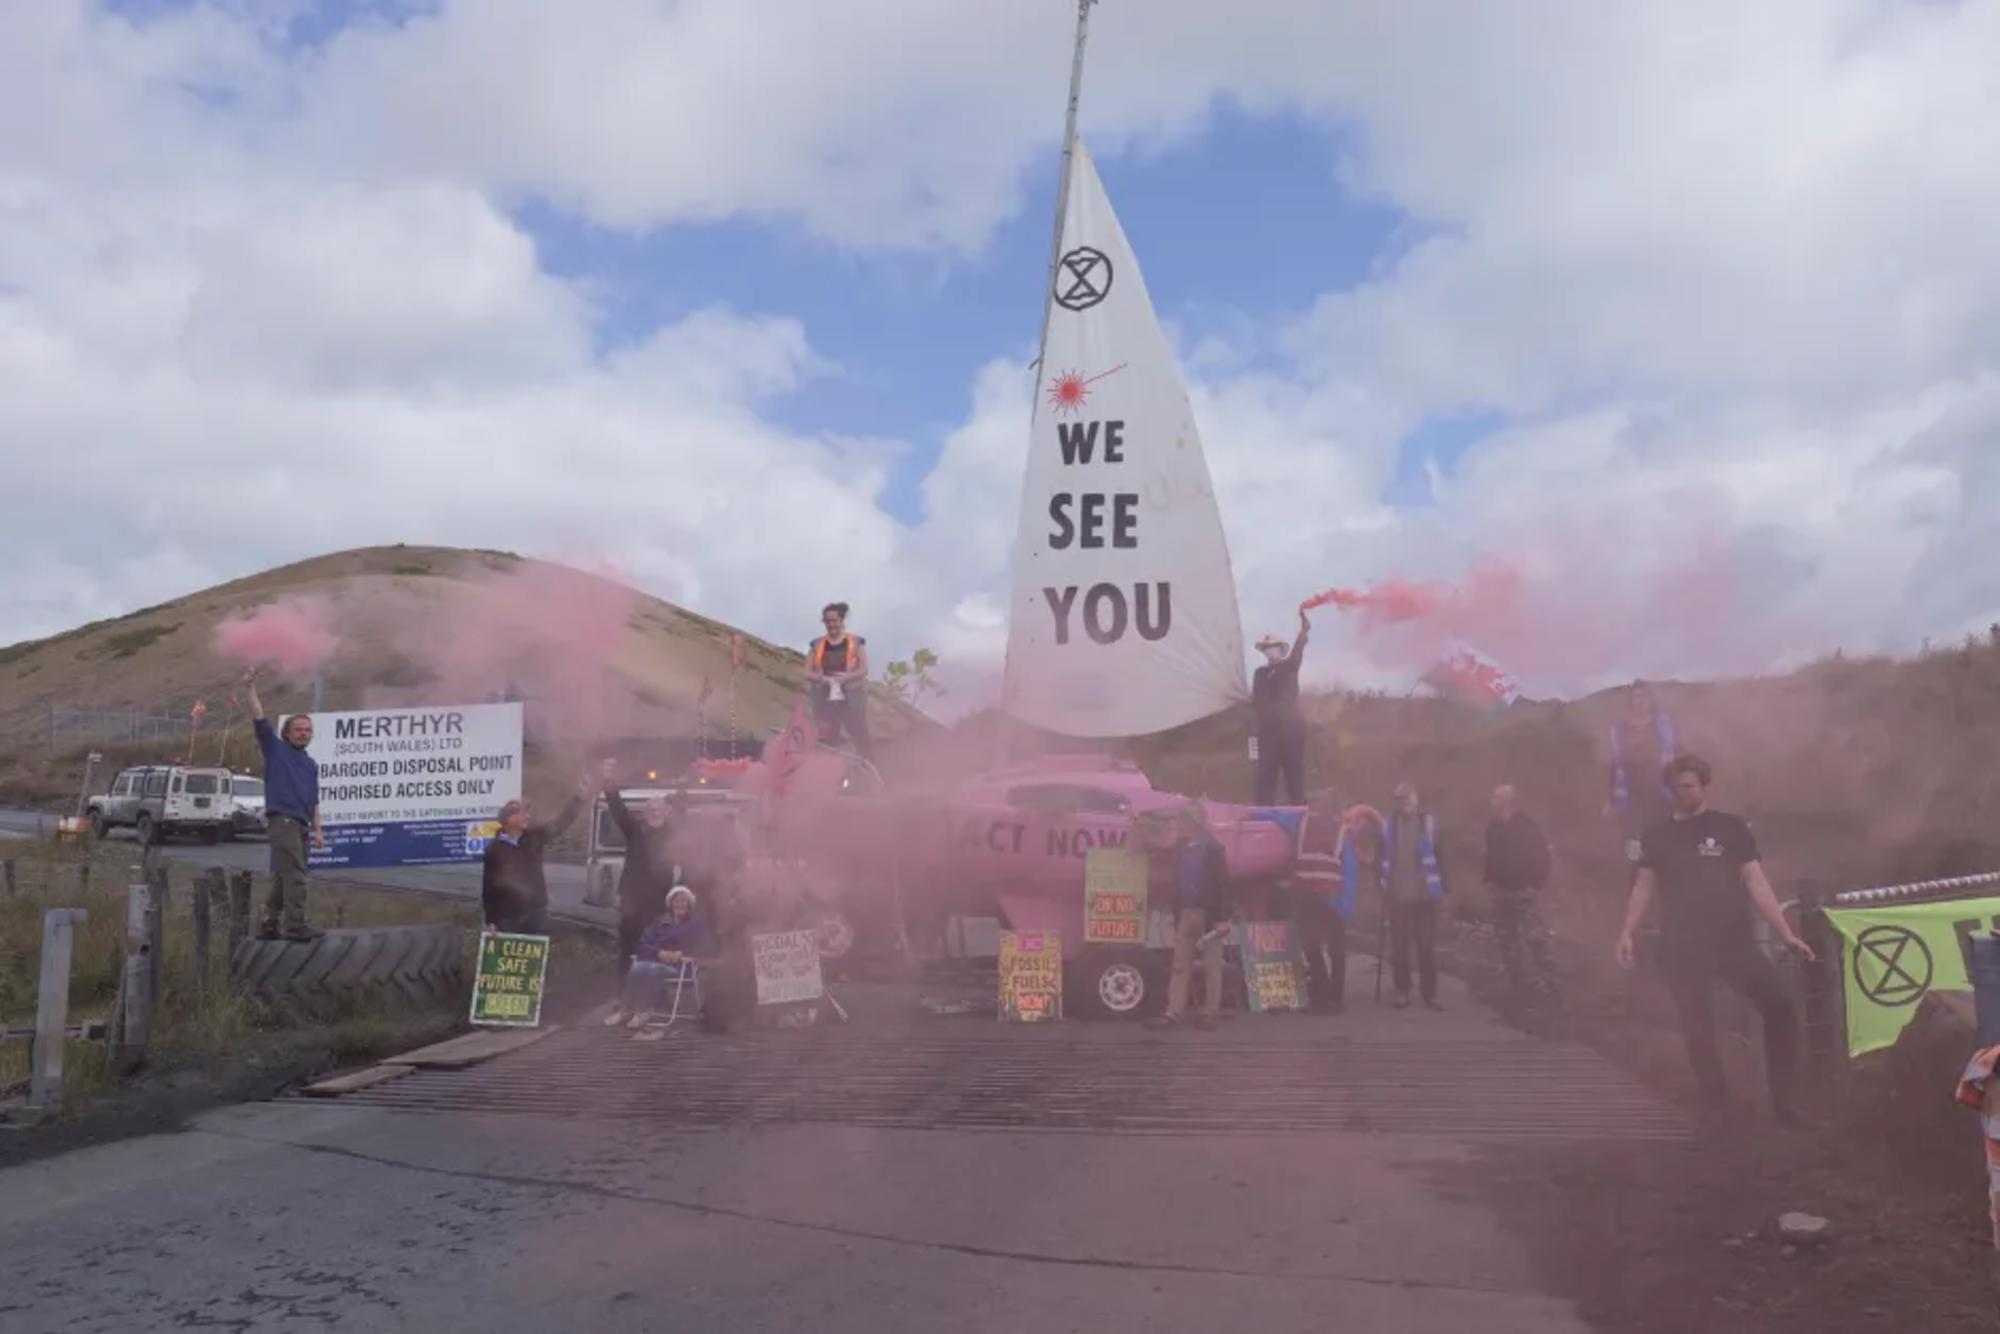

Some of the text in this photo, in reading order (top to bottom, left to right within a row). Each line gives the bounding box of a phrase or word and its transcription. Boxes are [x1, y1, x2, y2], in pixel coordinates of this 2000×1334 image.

[1057, 420, 1125, 465] WE
[1048, 492, 1139, 550] SEE
[1042, 582, 1171, 645] YOU
[335, 711, 464, 739] MERTHYR
[335, 737, 463, 757] (SOUTH WALES) LTD
[320, 754, 513, 779] BARGOED DISPOSAL POINT
[319, 778, 495, 801] THORISED ACCESS ONLY
[957, 818, 1128, 859] ACT NOW
[1088, 919, 1137, 937] FUTURE
[487, 940, 543, 958] A CLEAN
[497, 957, 529, 973] SAFE
[1010, 956, 1051, 972] FOSSIL
[479, 974, 541, 992] FUTURE IS
